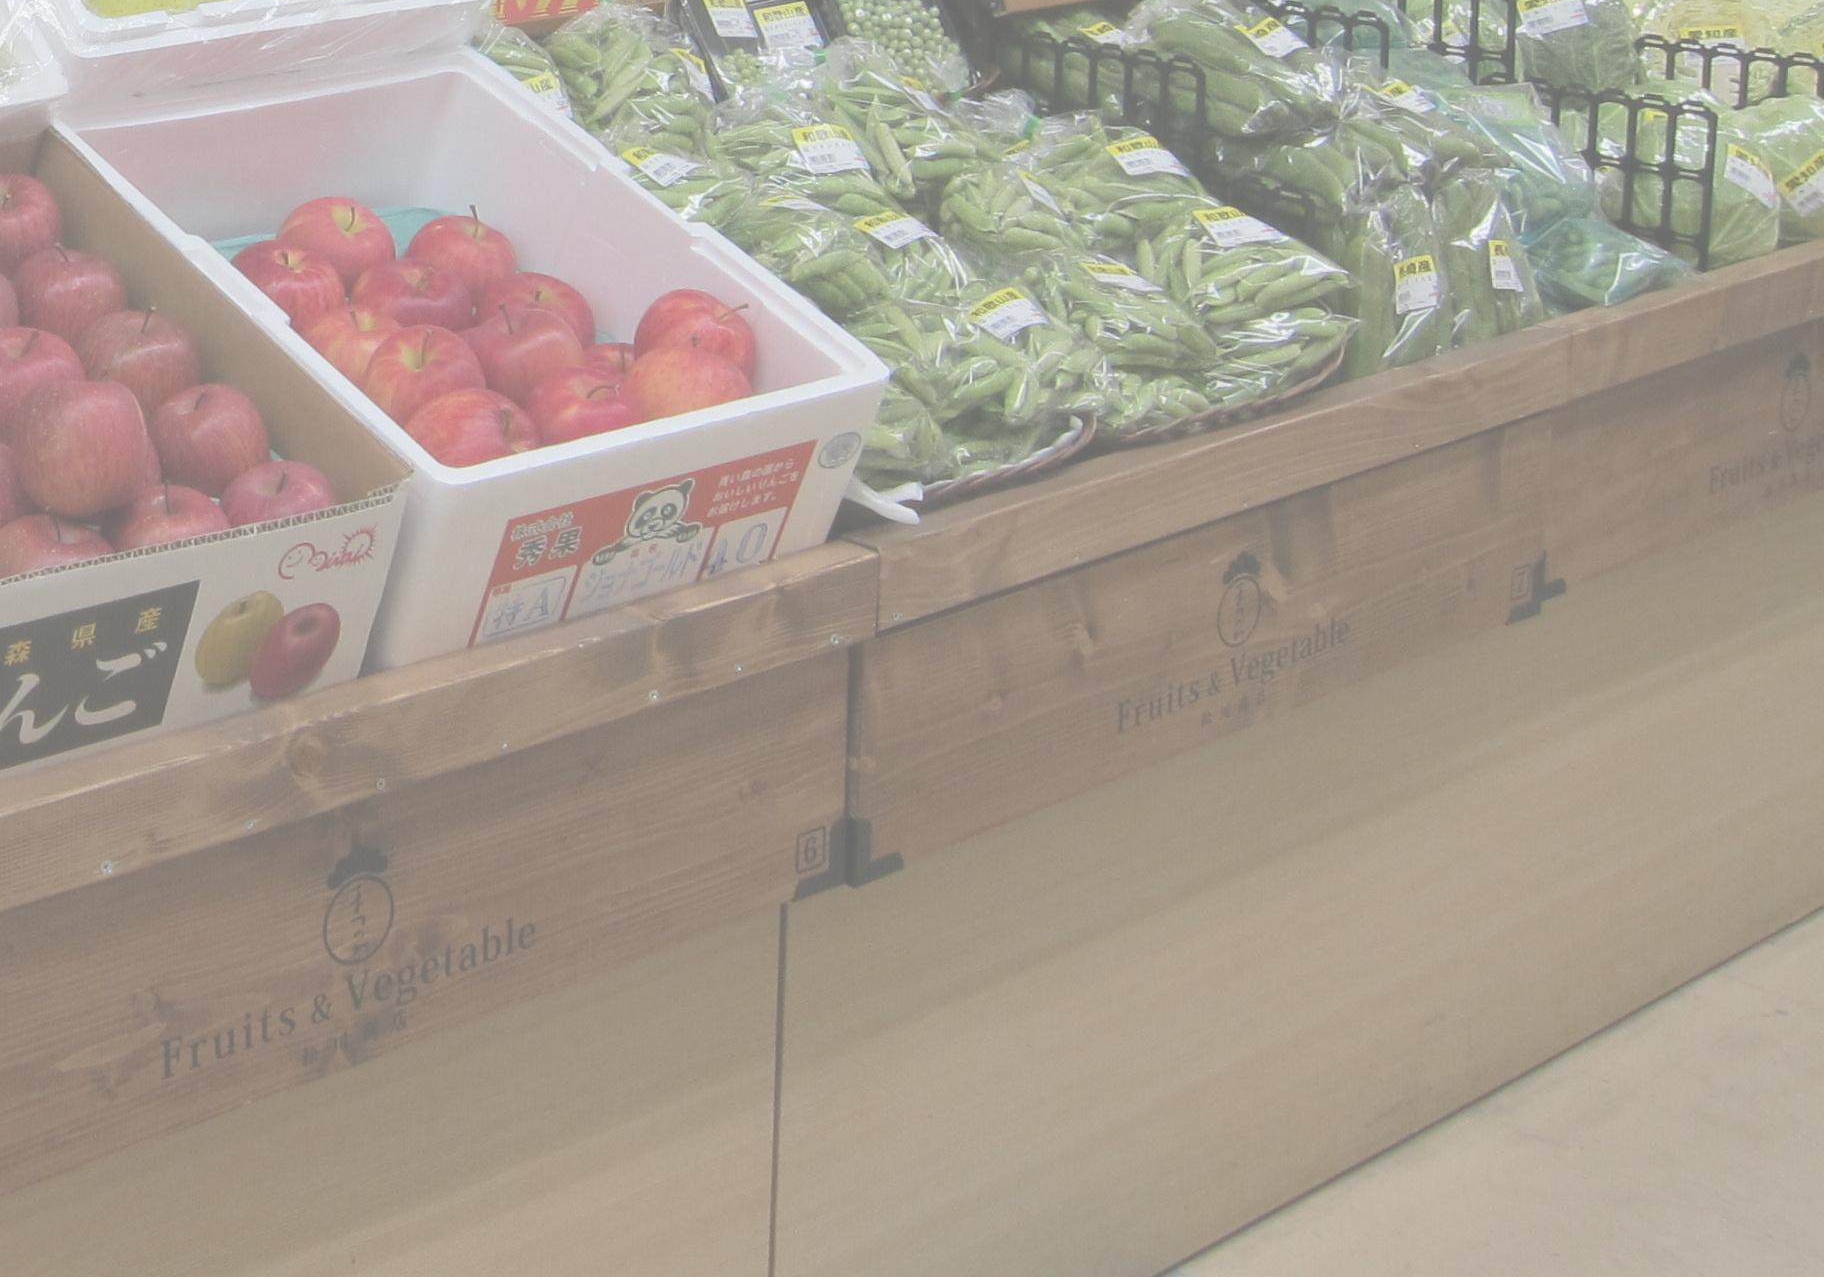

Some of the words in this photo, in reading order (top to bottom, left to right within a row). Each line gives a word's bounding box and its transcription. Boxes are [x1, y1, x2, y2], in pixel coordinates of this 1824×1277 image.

[512, 527, 583, 571] 秀果
[1116, 680, 1201, 734] Fruits
[1207, 670, 1222, 698] &
[1228, 616, 1351, 688] Vegetable
[160, 1006, 297, 1081] Fruits
[309, 992, 334, 1026] &
[344, 916, 538, 1014] Vegetable
